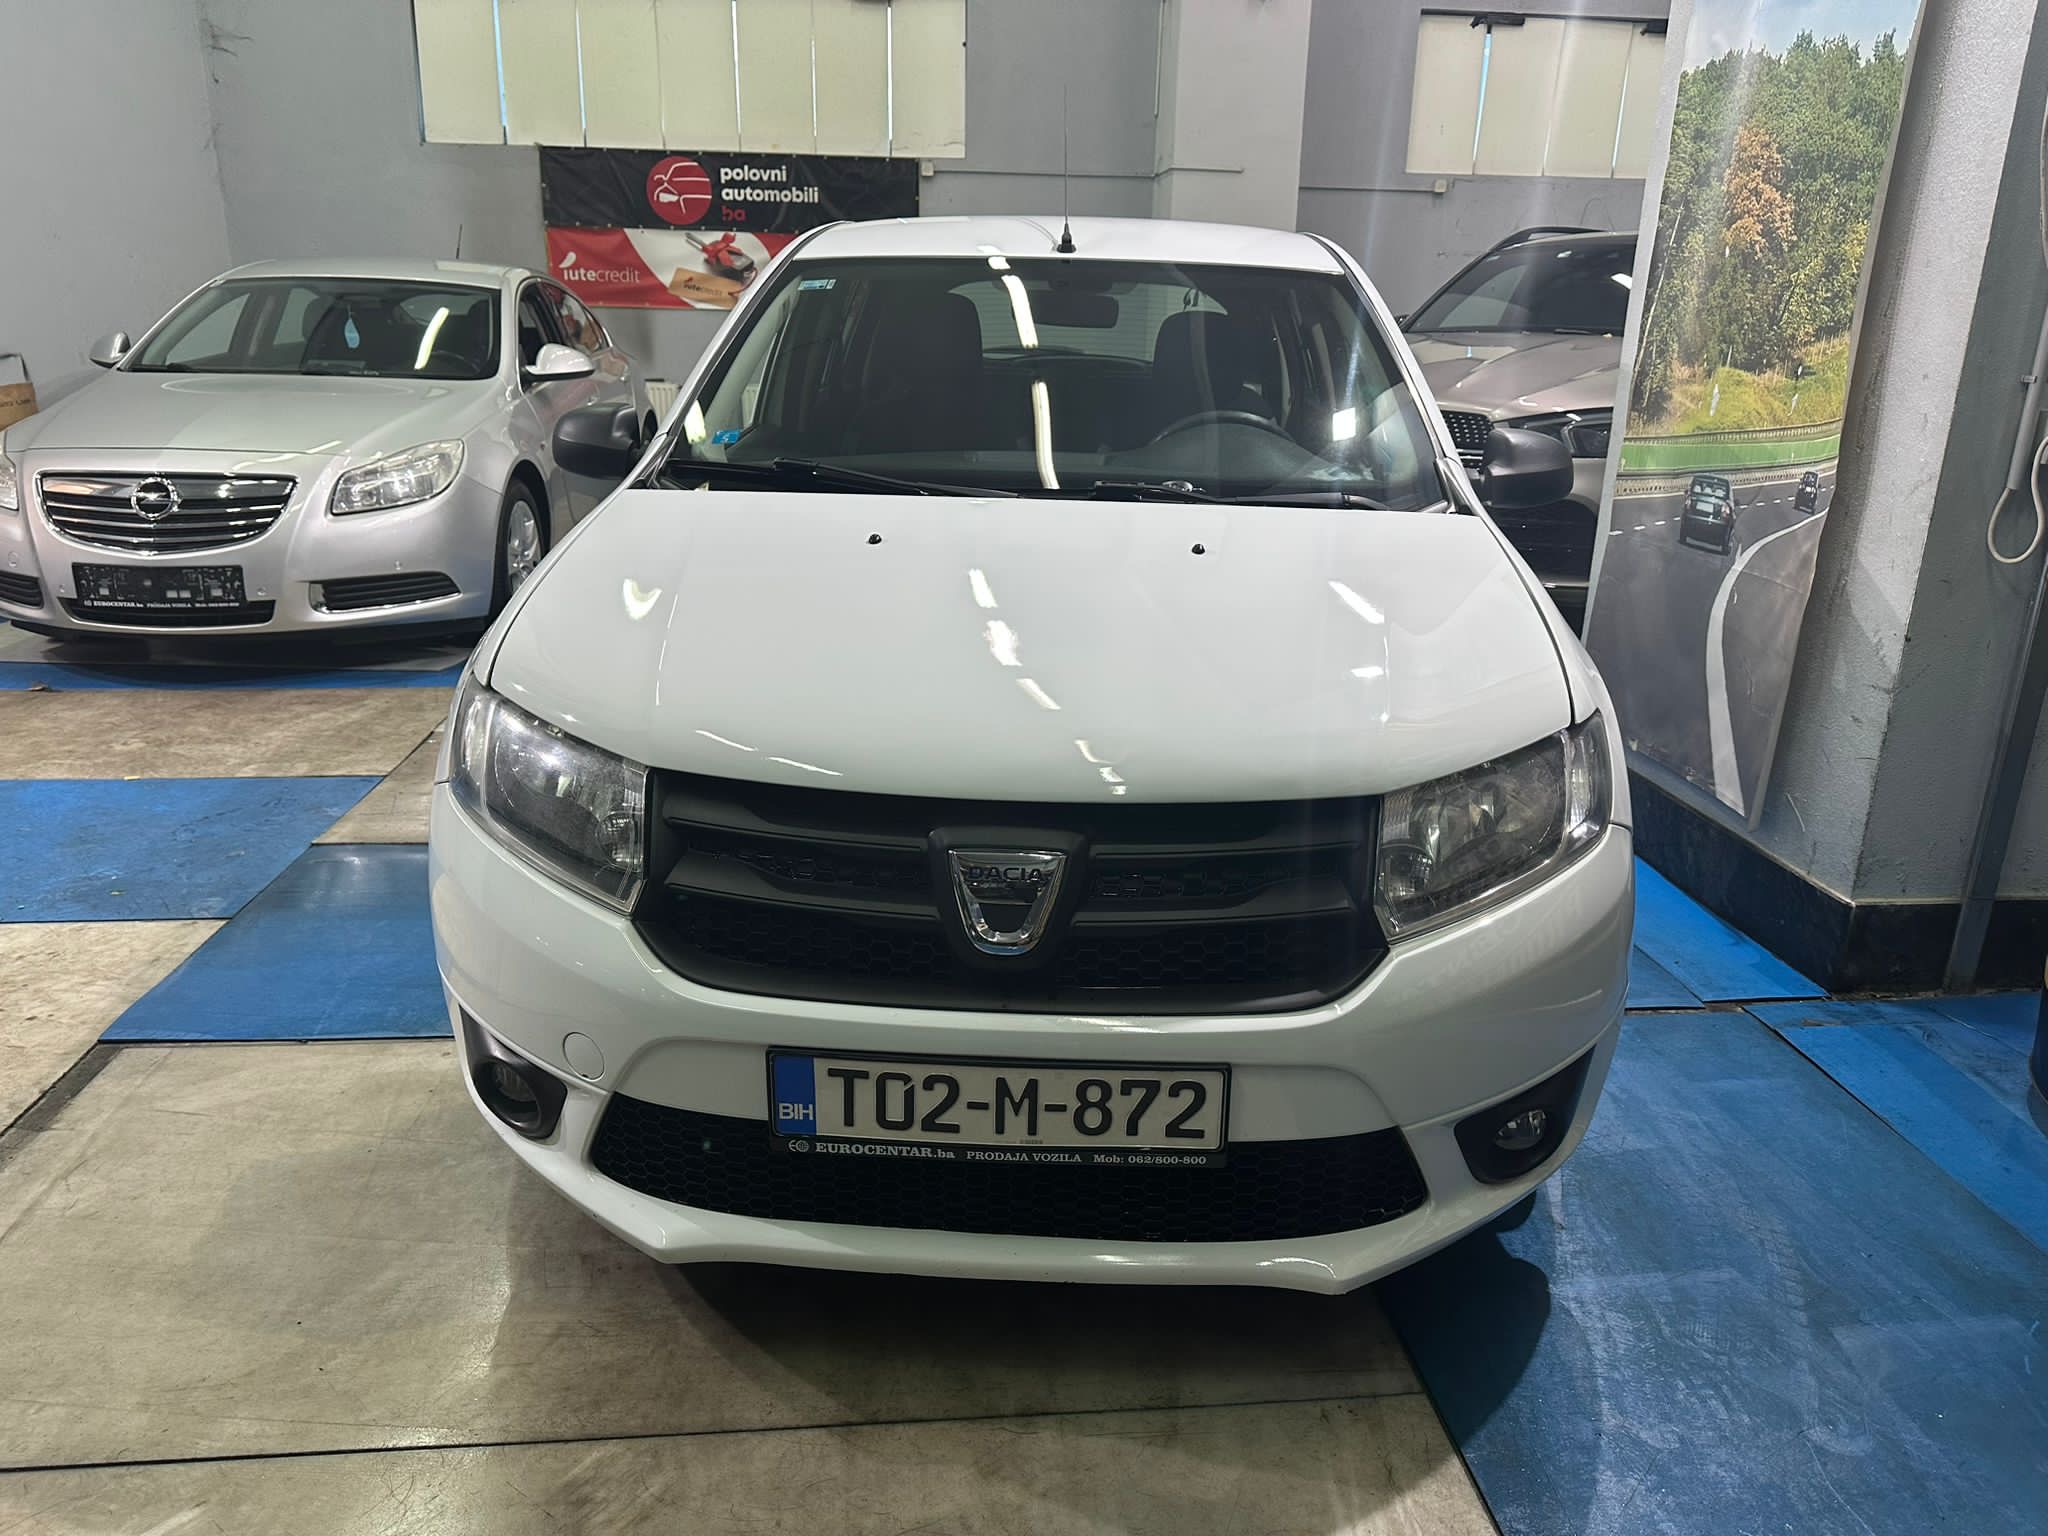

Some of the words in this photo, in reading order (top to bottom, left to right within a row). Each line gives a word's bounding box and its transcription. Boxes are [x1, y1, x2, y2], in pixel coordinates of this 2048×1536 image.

[720, 164, 787, 184] polovni
[721, 186, 819, 204] automobili
[563, 267, 640, 283] iutecredit
[967, 867, 1043, 881] DACIA
[778, 1103, 814, 1121] BIH
[827, 1067, 1207, 1141] T02-M-872
[816, 1142, 955, 1159] EUROCENTAR.ba
[966, 1151, 1029, 1162] PRODAJA
[1033, 1153, 1082, 1163] VOZILA
[1093, 1153, 1125, 1164] Mob:
[1128, 1155, 1207, 1165] 062/800-800
